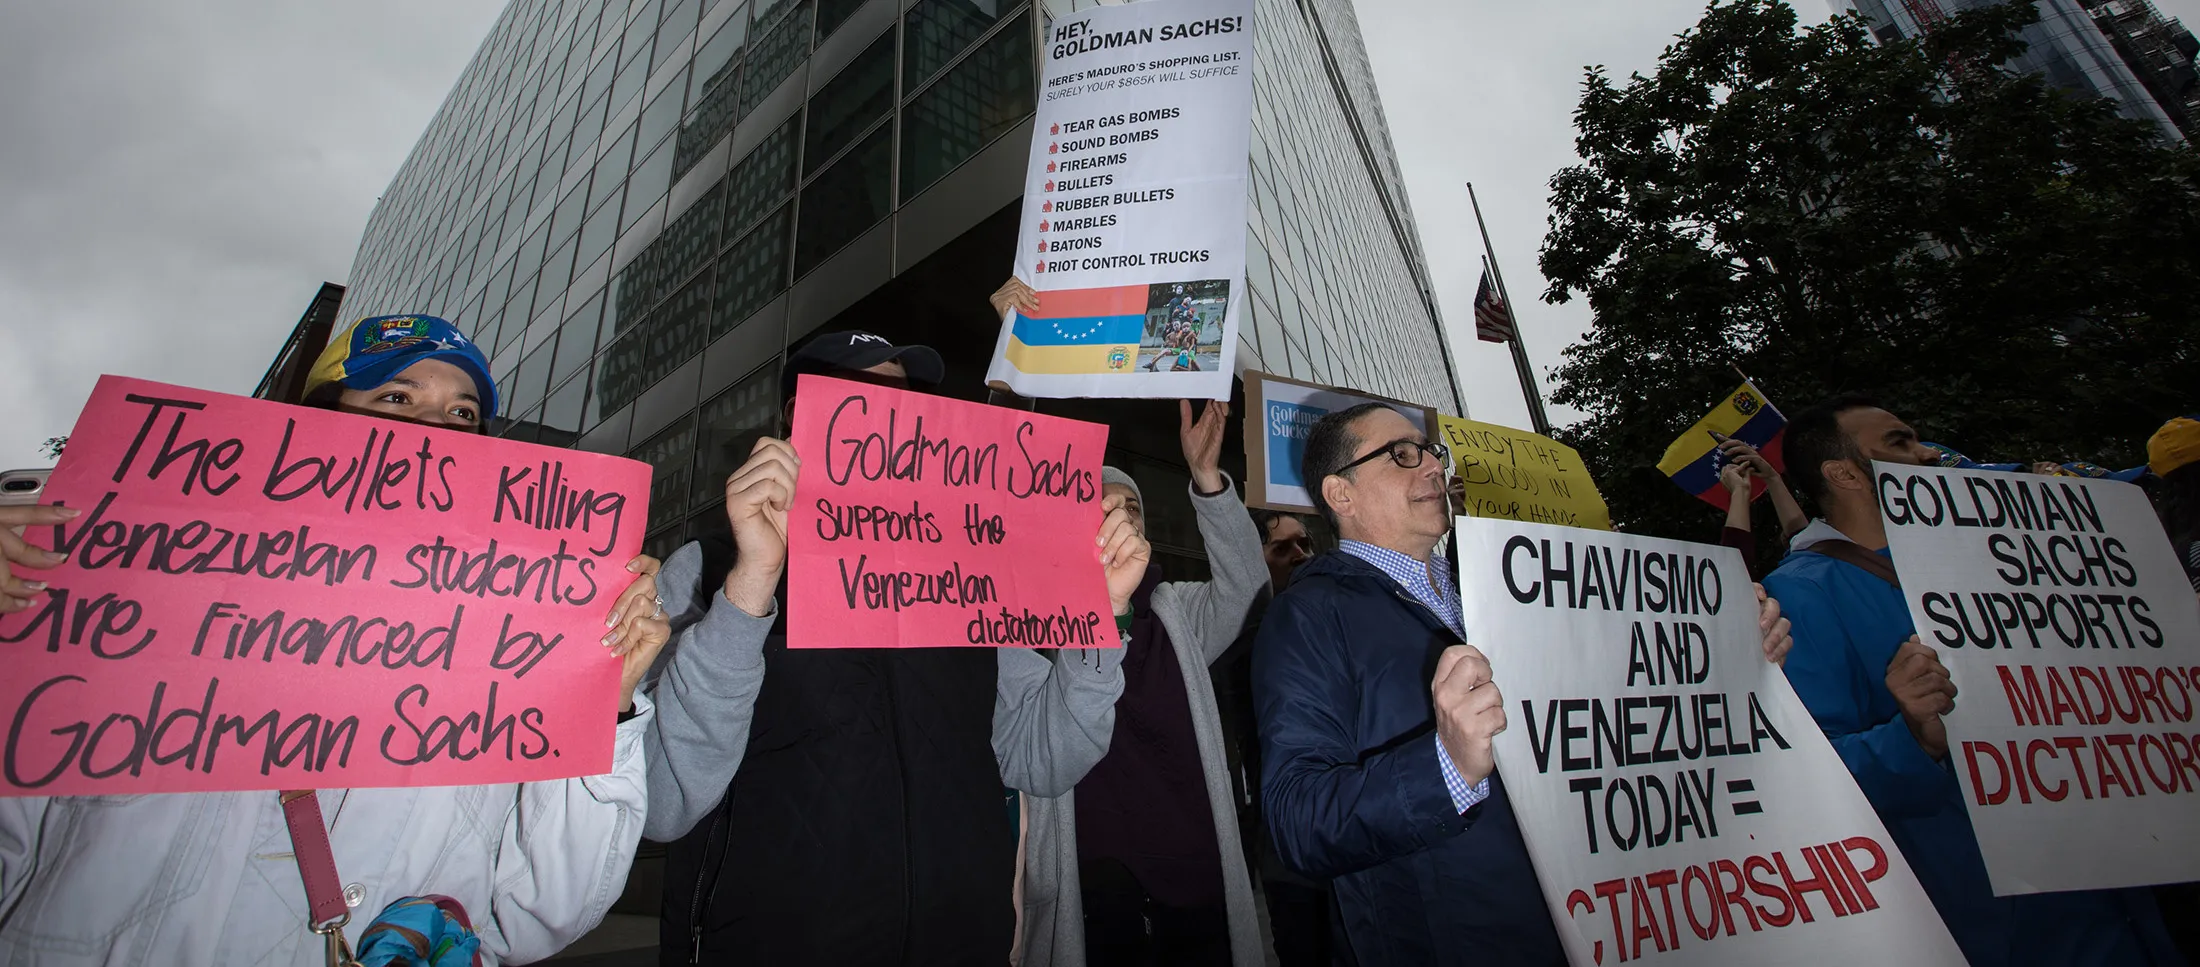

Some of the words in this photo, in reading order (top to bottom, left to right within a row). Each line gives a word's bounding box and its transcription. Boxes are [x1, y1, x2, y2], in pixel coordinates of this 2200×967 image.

[1053, 28, 1153, 60] GOLDMAN
[1159, 16, 1242, 41] SACHS!
[1055, 19, 1093, 43] HEY,
[1046, 85, 1084, 102] SURELY
[1086, 80, 1115, 94] YOUR
[1117, 75, 1156, 89] $865K
[1159, 72, 1186, 83] WILL
[1189, 65, 1239, 80] SUFFICE
[1048, 72, 1084, 88] HERE'S
[1086, 62, 1146, 79] MADURO'S
[1149, 56, 1210, 71] SHOPPING
[1213, 51, 1241, 64] LIST.
[1061, 136, 1105, 153] SOUND
[1109, 129, 1159, 146] BOMBS
[1063, 119, 1095, 134] TEAR
[1099, 114, 1125, 128] GAS
[1129, 107, 1180, 124] BOMBS
[1057, 174, 1114, 192] BULLETS
[1060, 153, 1127, 173] FIREARMS
[1055, 195, 1110, 212] RUBBER
[1113, 188, 1175, 205] BULLETS
[1050, 236, 1102, 252] BATONS
[1052, 214, 1117, 232] MARBLES
[1048, 260, 1078, 273] RIOT
[1082, 254, 1146, 270] CONTROL
[1150, 249, 1210, 265] TRUCKS
[1270, 405, 1324, 425] Goldma
[1272, 420, 1311, 439] Sucks
[111, 393, 242, 497] The
[262, 419, 456, 513] bullets
[826, 395, 998, 490] Goldman
[1008, 421, 1096, 504] Sachs
[1444, 424, 1516, 467] ENJOY
[1516, 438, 1567, 472] THE
[1463, 454, 1539, 495] BLOOD
[1549, 478, 1571, 498] IN
[1469, 496, 1523, 522] YOUR
[1879, 473, 2104, 533] GOLDMAN
[52, 491, 377, 588] Venezuelan
[390, 536, 596, 604] students
[1989, 534, 2137, 587] SACHS
[838, 554, 997, 612] Venezuelan
[1502, 535, 1722, 615] CHAVISMO
[1922, 591, 2164, 649] SUPPORTS
[490, 612, 564, 679] by
[1627, 621, 1709, 686] AND
[3, 674, 360, 788] Goldman
[380, 682, 561, 766] Sachs.
[1522, 692, 1791, 773] VENEZUELA
[1569, 768, 1719, 854] TODAY
